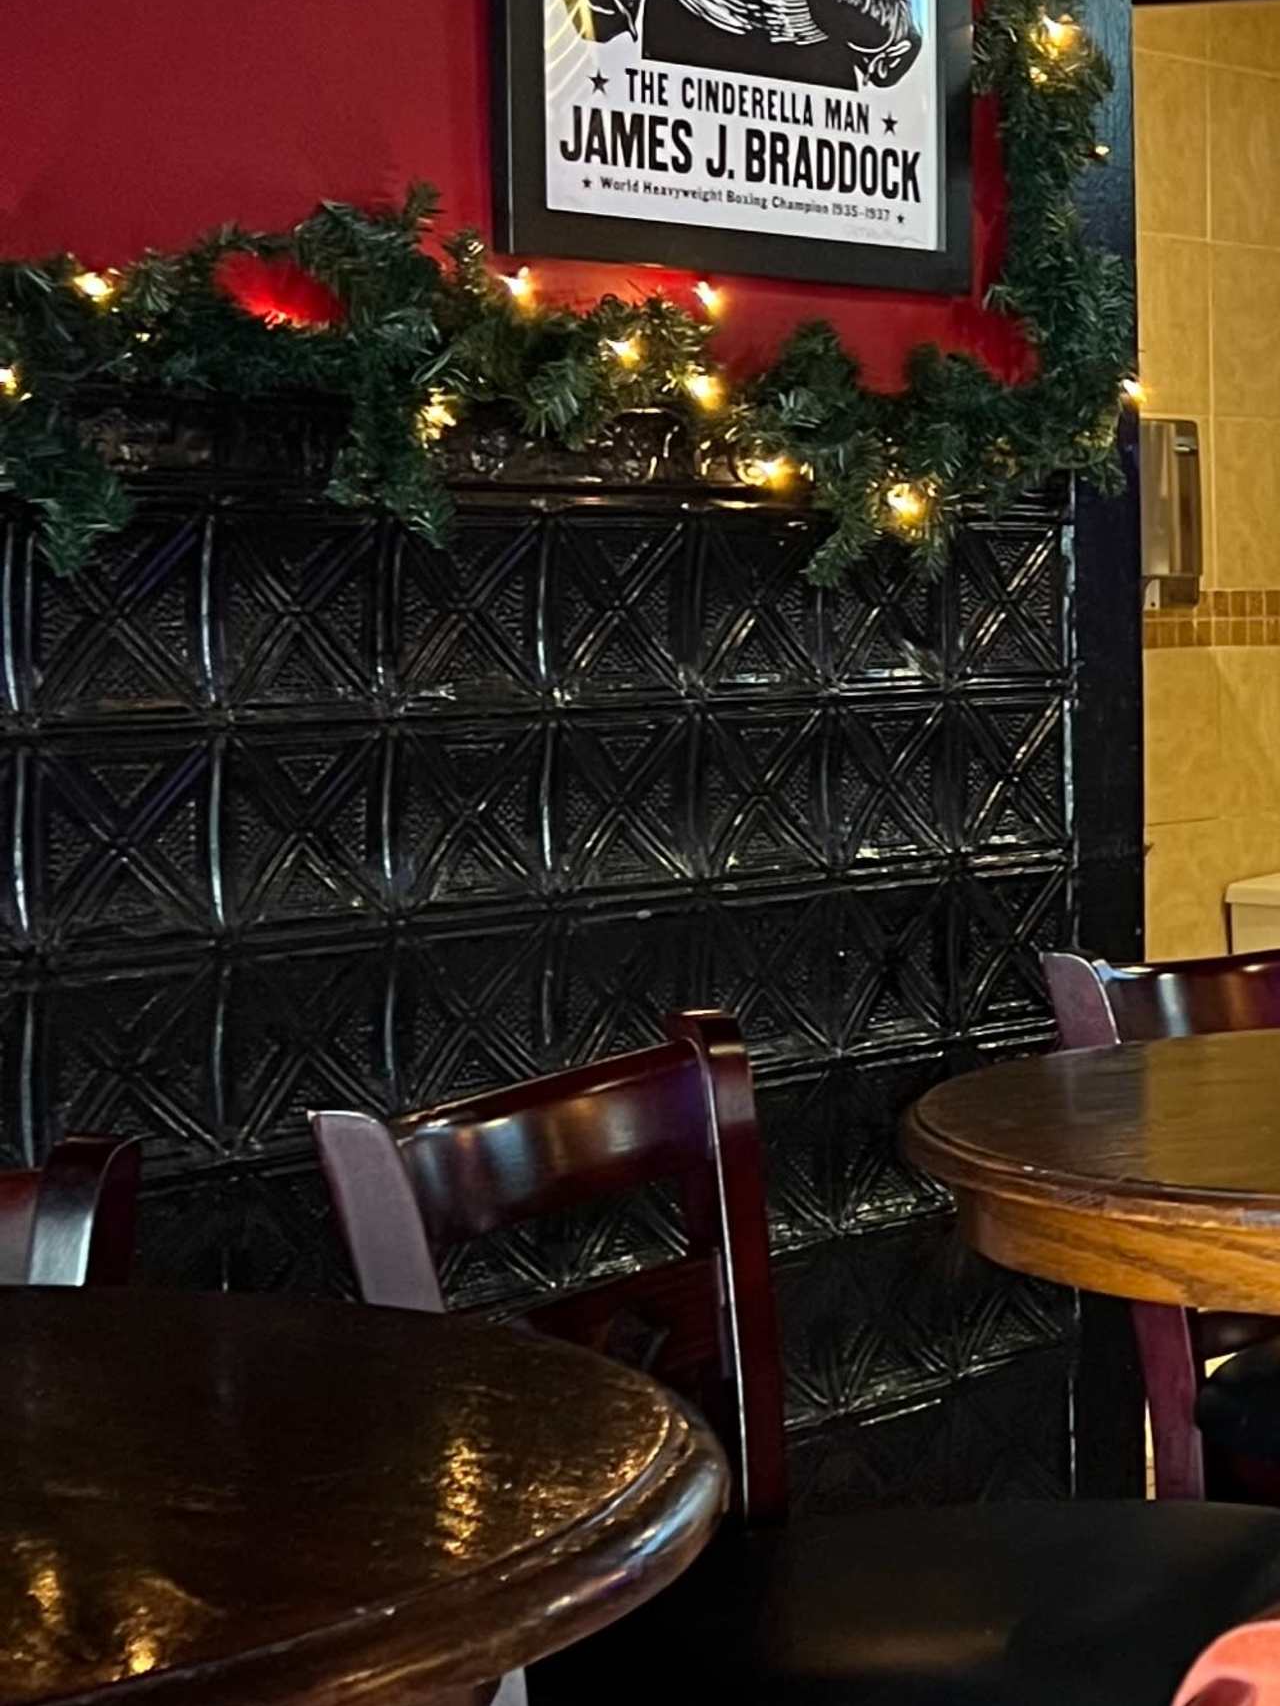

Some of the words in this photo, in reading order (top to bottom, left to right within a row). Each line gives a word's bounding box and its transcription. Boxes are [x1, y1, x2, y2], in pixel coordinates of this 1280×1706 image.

[625, 68, 669, 106] THE
[681, 77, 814, 127] CINDERELLA
[825, 97, 869, 135] MAN
[559, 105, 693, 174] JAMES
[705, 124, 735, 180] J.
[745, 128, 921, 203] BRADDOCK
[600, 176, 639, 193] World
[643, 182, 723, 202] Heavyweight
[727, 190, 767, 210] Boxing
[772, 195, 829, 214] Champion
